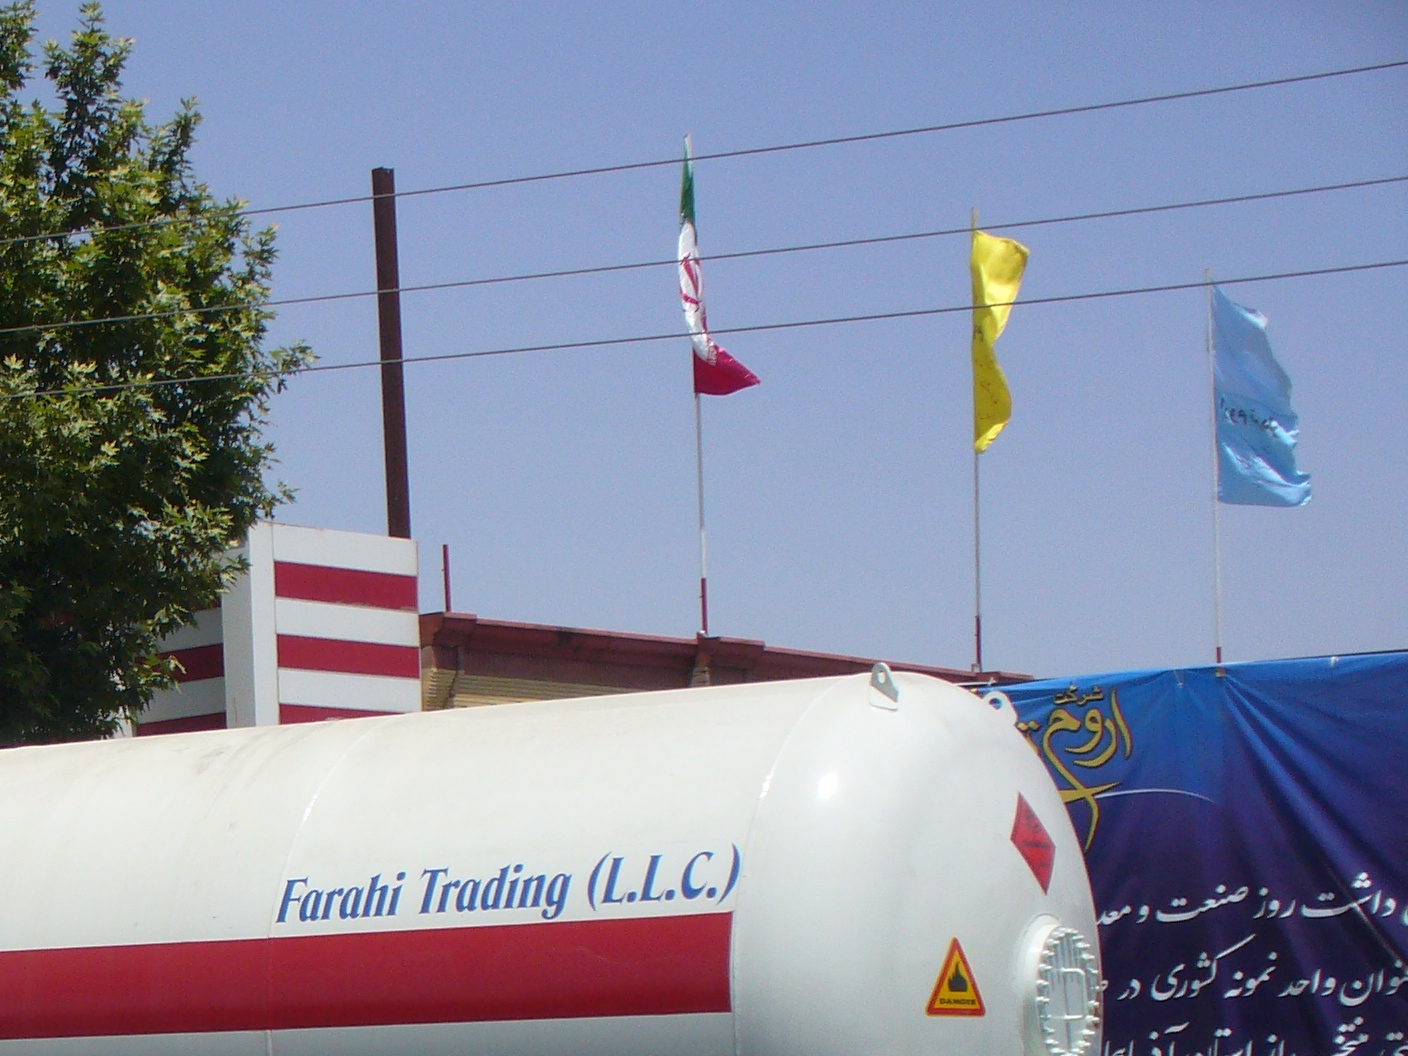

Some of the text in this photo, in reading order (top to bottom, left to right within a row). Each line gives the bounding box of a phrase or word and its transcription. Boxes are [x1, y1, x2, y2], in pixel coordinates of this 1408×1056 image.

[1052, 681, 1105, 706] شرکت
[275, 842, 741, 924] Farahi Trading (L.L.C.)
[1300, 870, 1396, 918] داشت
[1095, 903, 1132, 926] معد
[1136, 904, 1150, 924] و
[1155, 883, 1249, 923] صنعت
[1252, 885, 1296, 920] روز
[1116, 933, 1408, 1007] نوان واحد نمونه کشوری در
[938, 997, 977, 1007] DANGER
